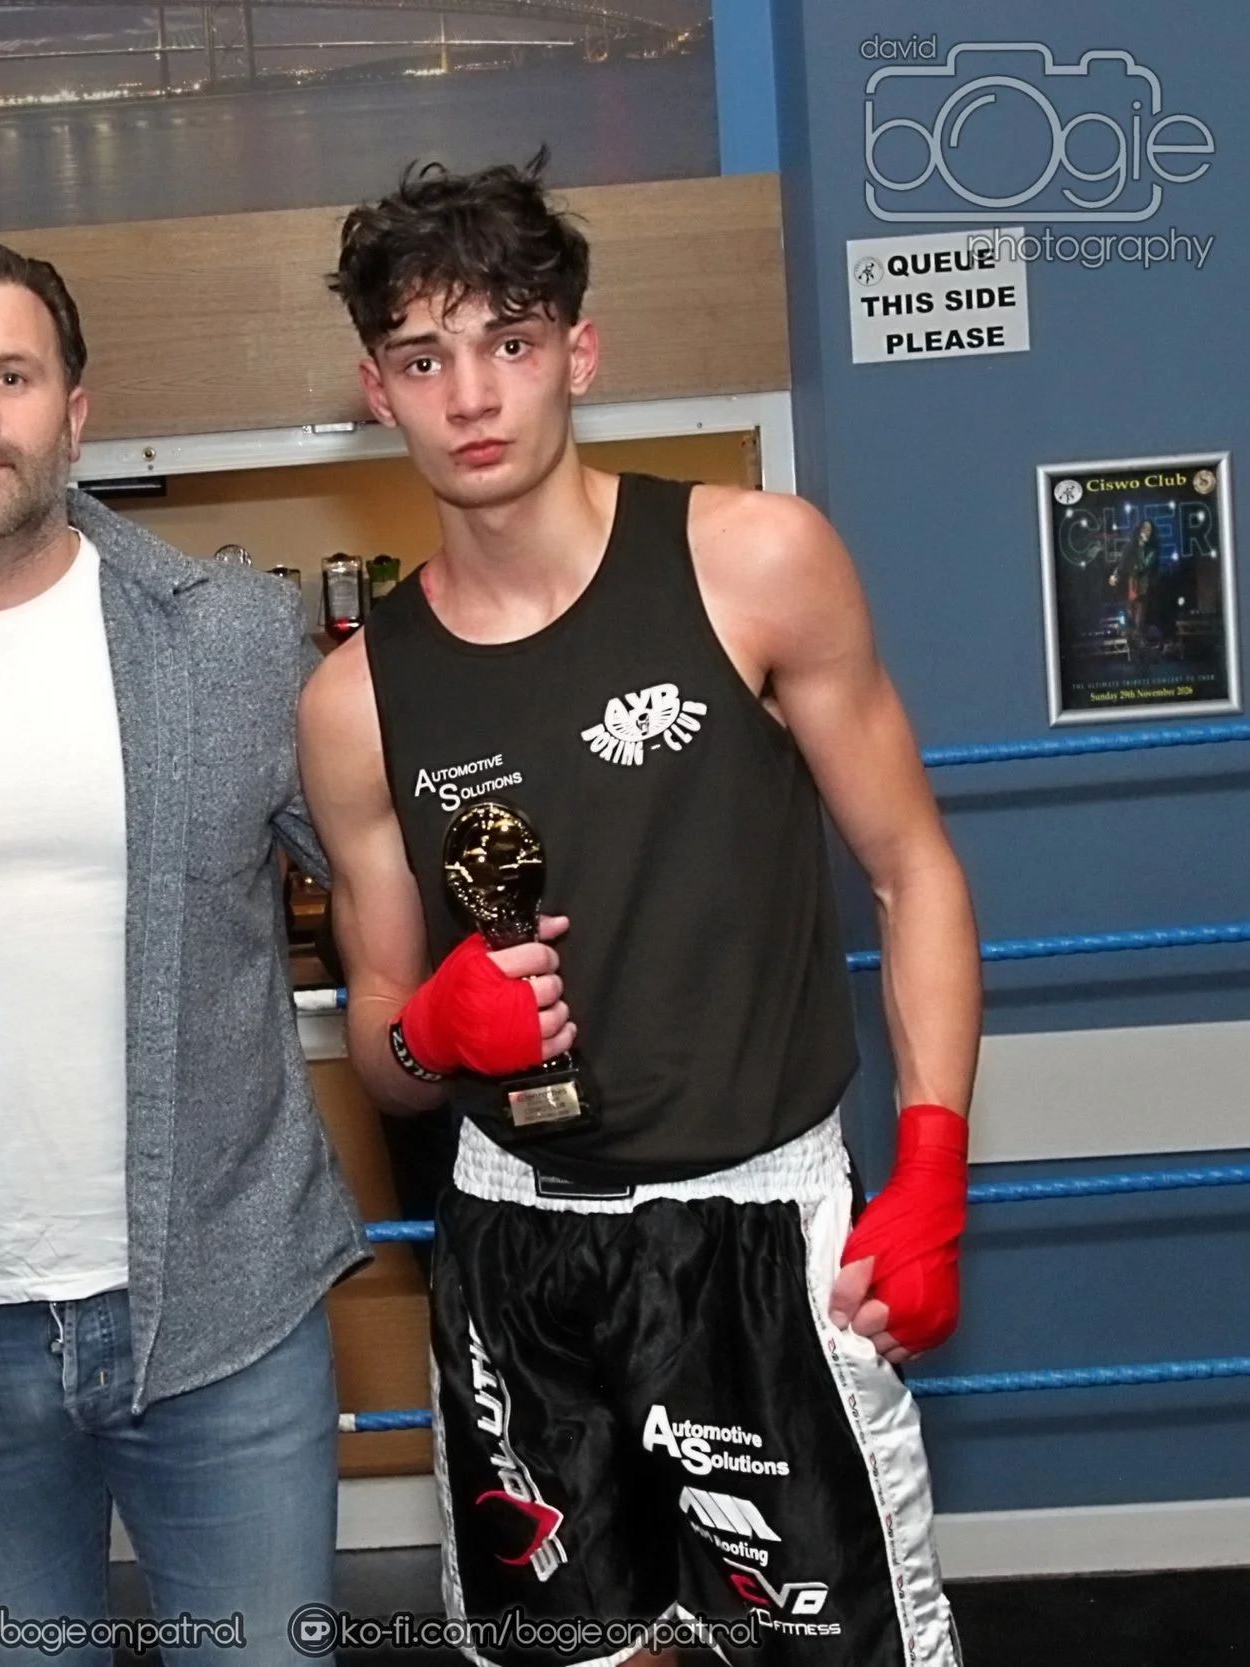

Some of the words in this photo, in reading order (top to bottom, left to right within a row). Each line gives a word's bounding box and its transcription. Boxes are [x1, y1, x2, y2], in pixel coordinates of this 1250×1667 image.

[887, 248, 996, 277] QUEUE
[860, 291, 935, 318] THIS
[944, 285, 1017, 311] SIDE
[886, 326, 1006, 355] PLEASE
[1086, 478, 1140, 492] Ciswo
[1144, 472, 1187, 487] Club
[1059, 501, 1216, 568] CHER
[1090, 691, 1118, 702] Sunday
[1136, 687, 1176, 699] November
[642, 1404, 763, 1459] Automotive
[681, 1437, 791, 1476] Solutions
[773, 1620, 842, 1636] FITNESS
